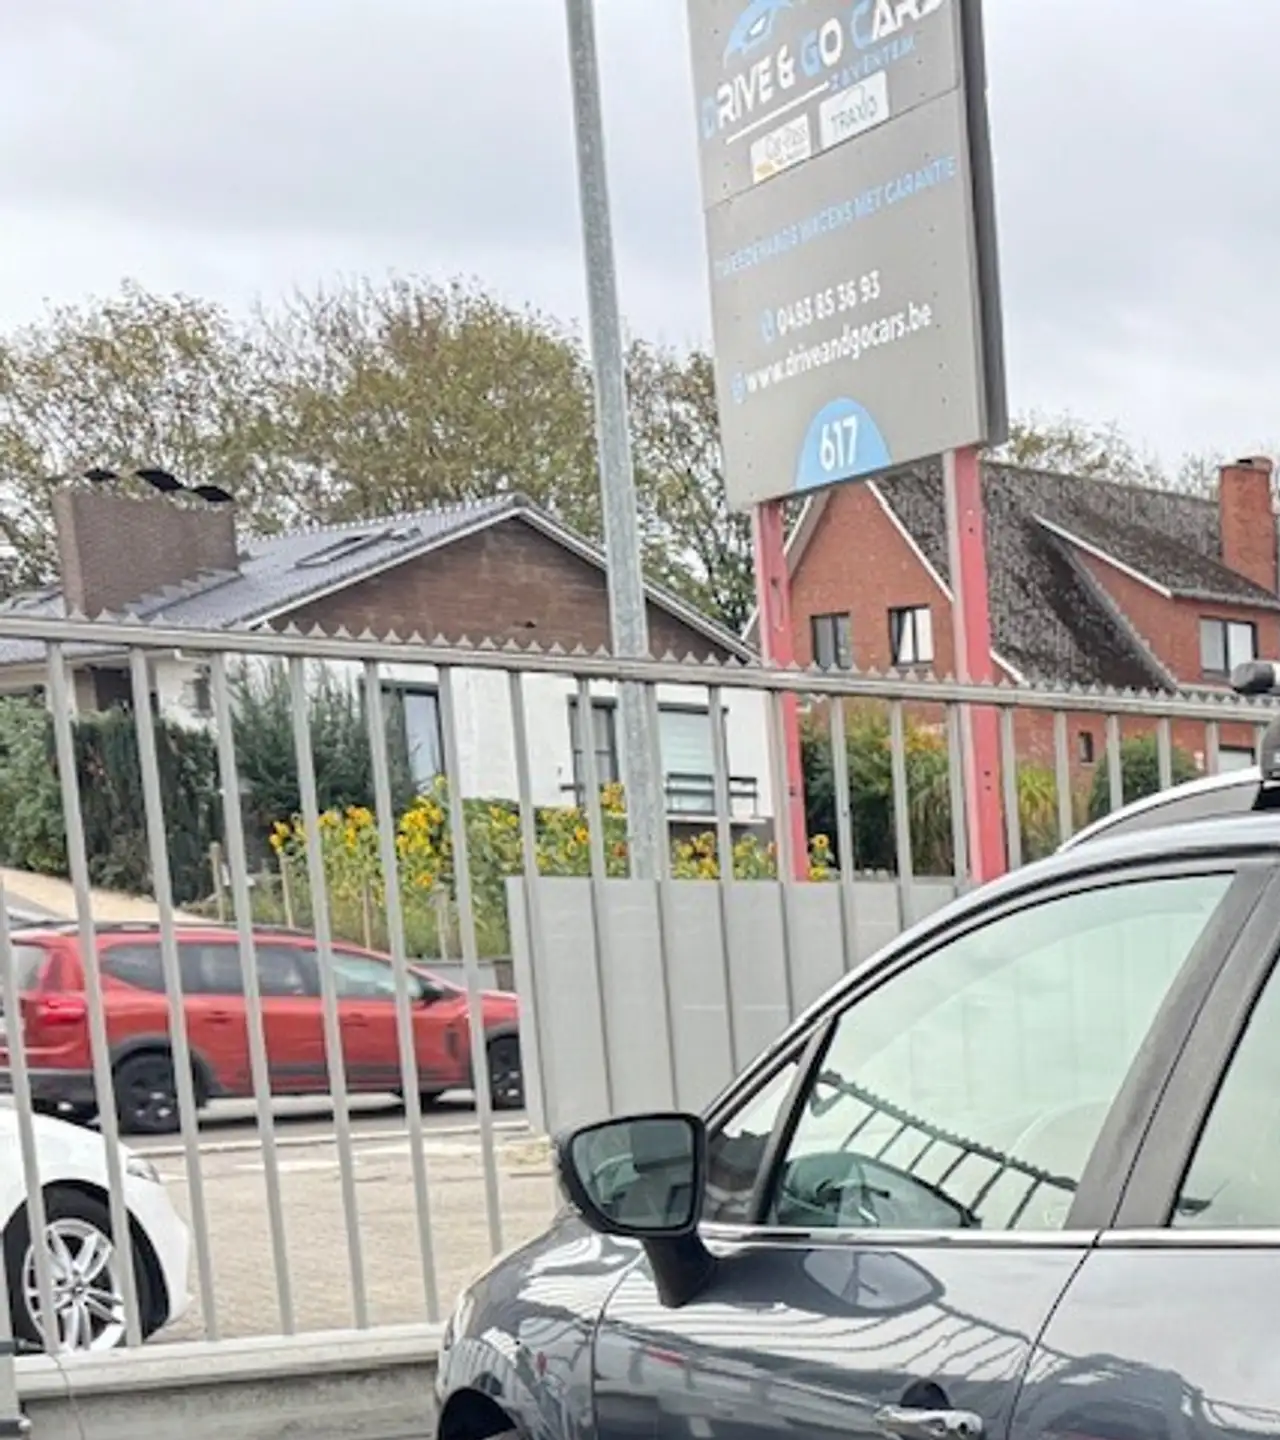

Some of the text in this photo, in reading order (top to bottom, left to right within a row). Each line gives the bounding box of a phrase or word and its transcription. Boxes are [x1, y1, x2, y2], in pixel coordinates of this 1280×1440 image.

[701, 54, 774, 138] DRIVE
[777, 45, 796, 89] &
[801, 17, 843, 77] GO
[859, 270, 881, 303] 93
[746, 301, 932, 393] www.driveandgocars.be
[819, 415, 858, 471] 617
